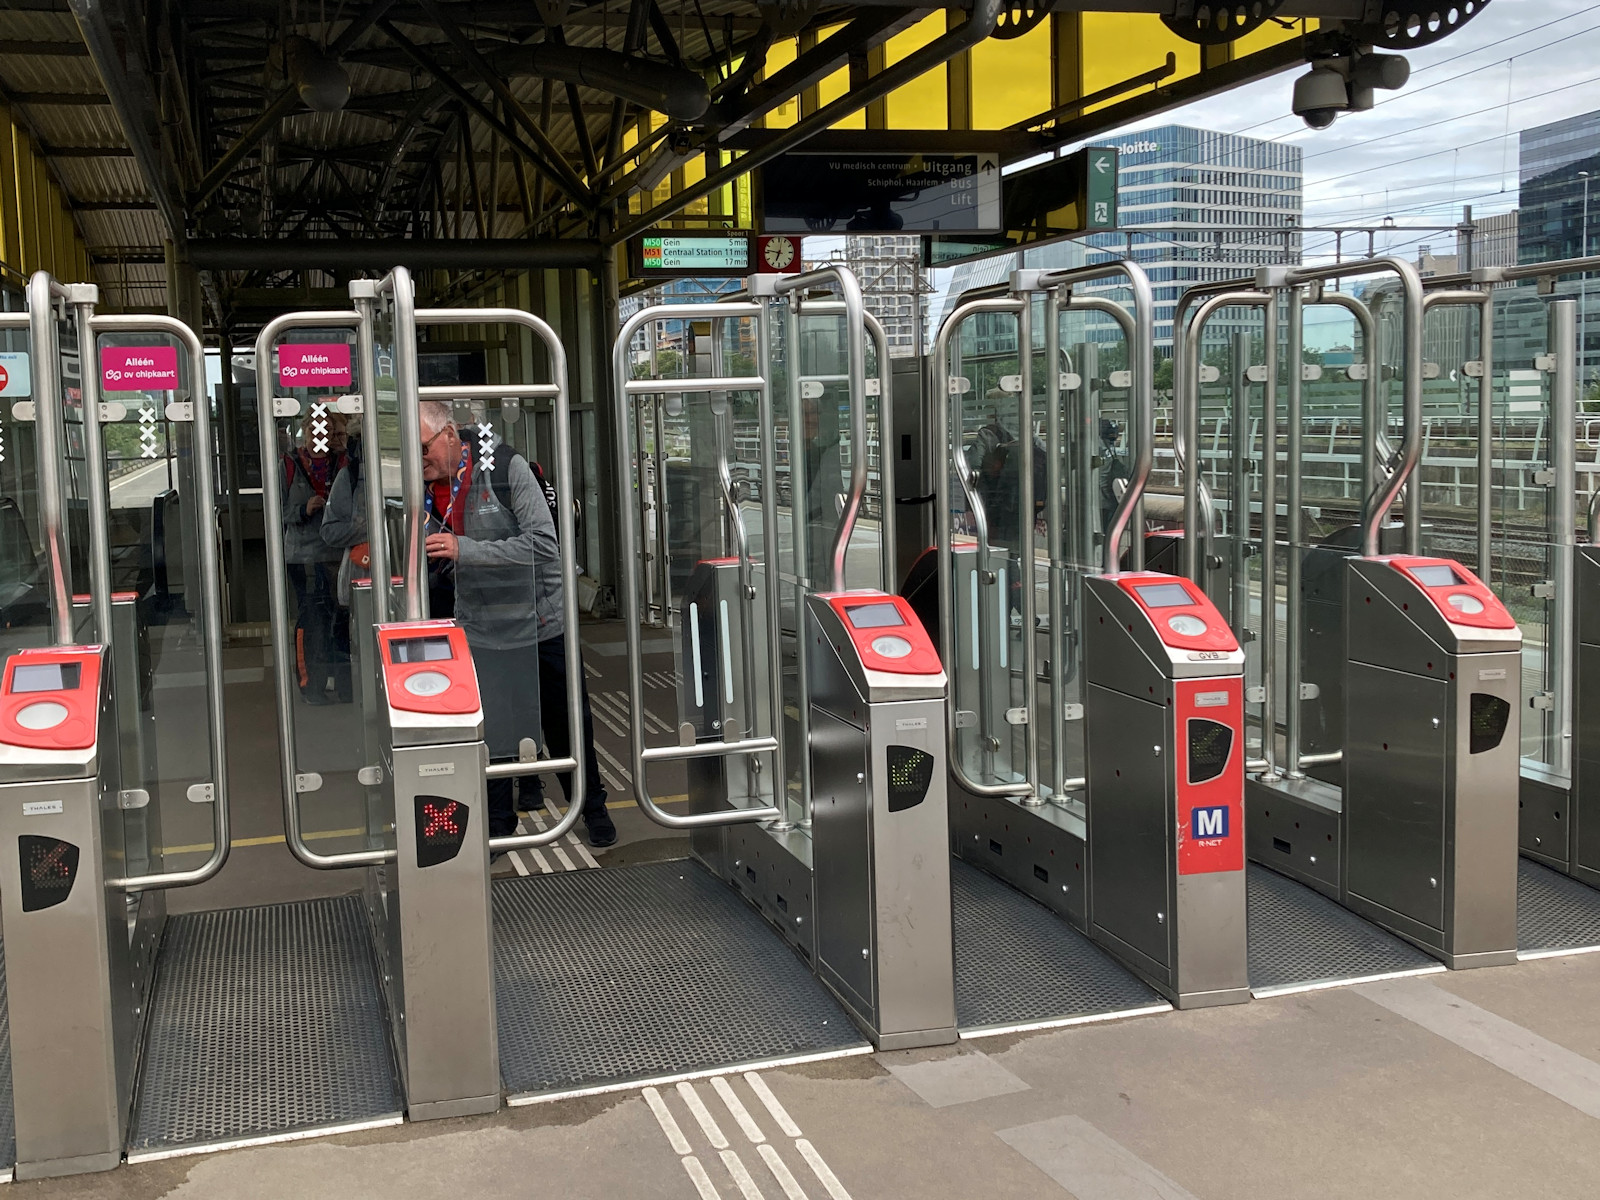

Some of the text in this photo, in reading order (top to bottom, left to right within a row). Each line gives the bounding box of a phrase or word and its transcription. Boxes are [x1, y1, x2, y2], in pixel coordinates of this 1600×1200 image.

[829, 161, 972, 176] VU medisch centrum Uitgang
[867, 178, 972, 189] Schiphol, Haarlem Bus
[951, 194, 972, 205] Lift
[644, 248, 748, 256] M51 Centraal Station 11 min
[644, 258, 748, 266] M50 Gein 17 min
[125, 357, 154, 367] Alléén
[301, 355, 329, 363] Alléén
[124, 369, 175, 379] ov chipkaart
[311, 366, 349, 376] chipkaart
[1198, 652, 1219, 660] GVB
[29, 804, 57, 812] THALES
[1197, 808, 1223, 836] M
